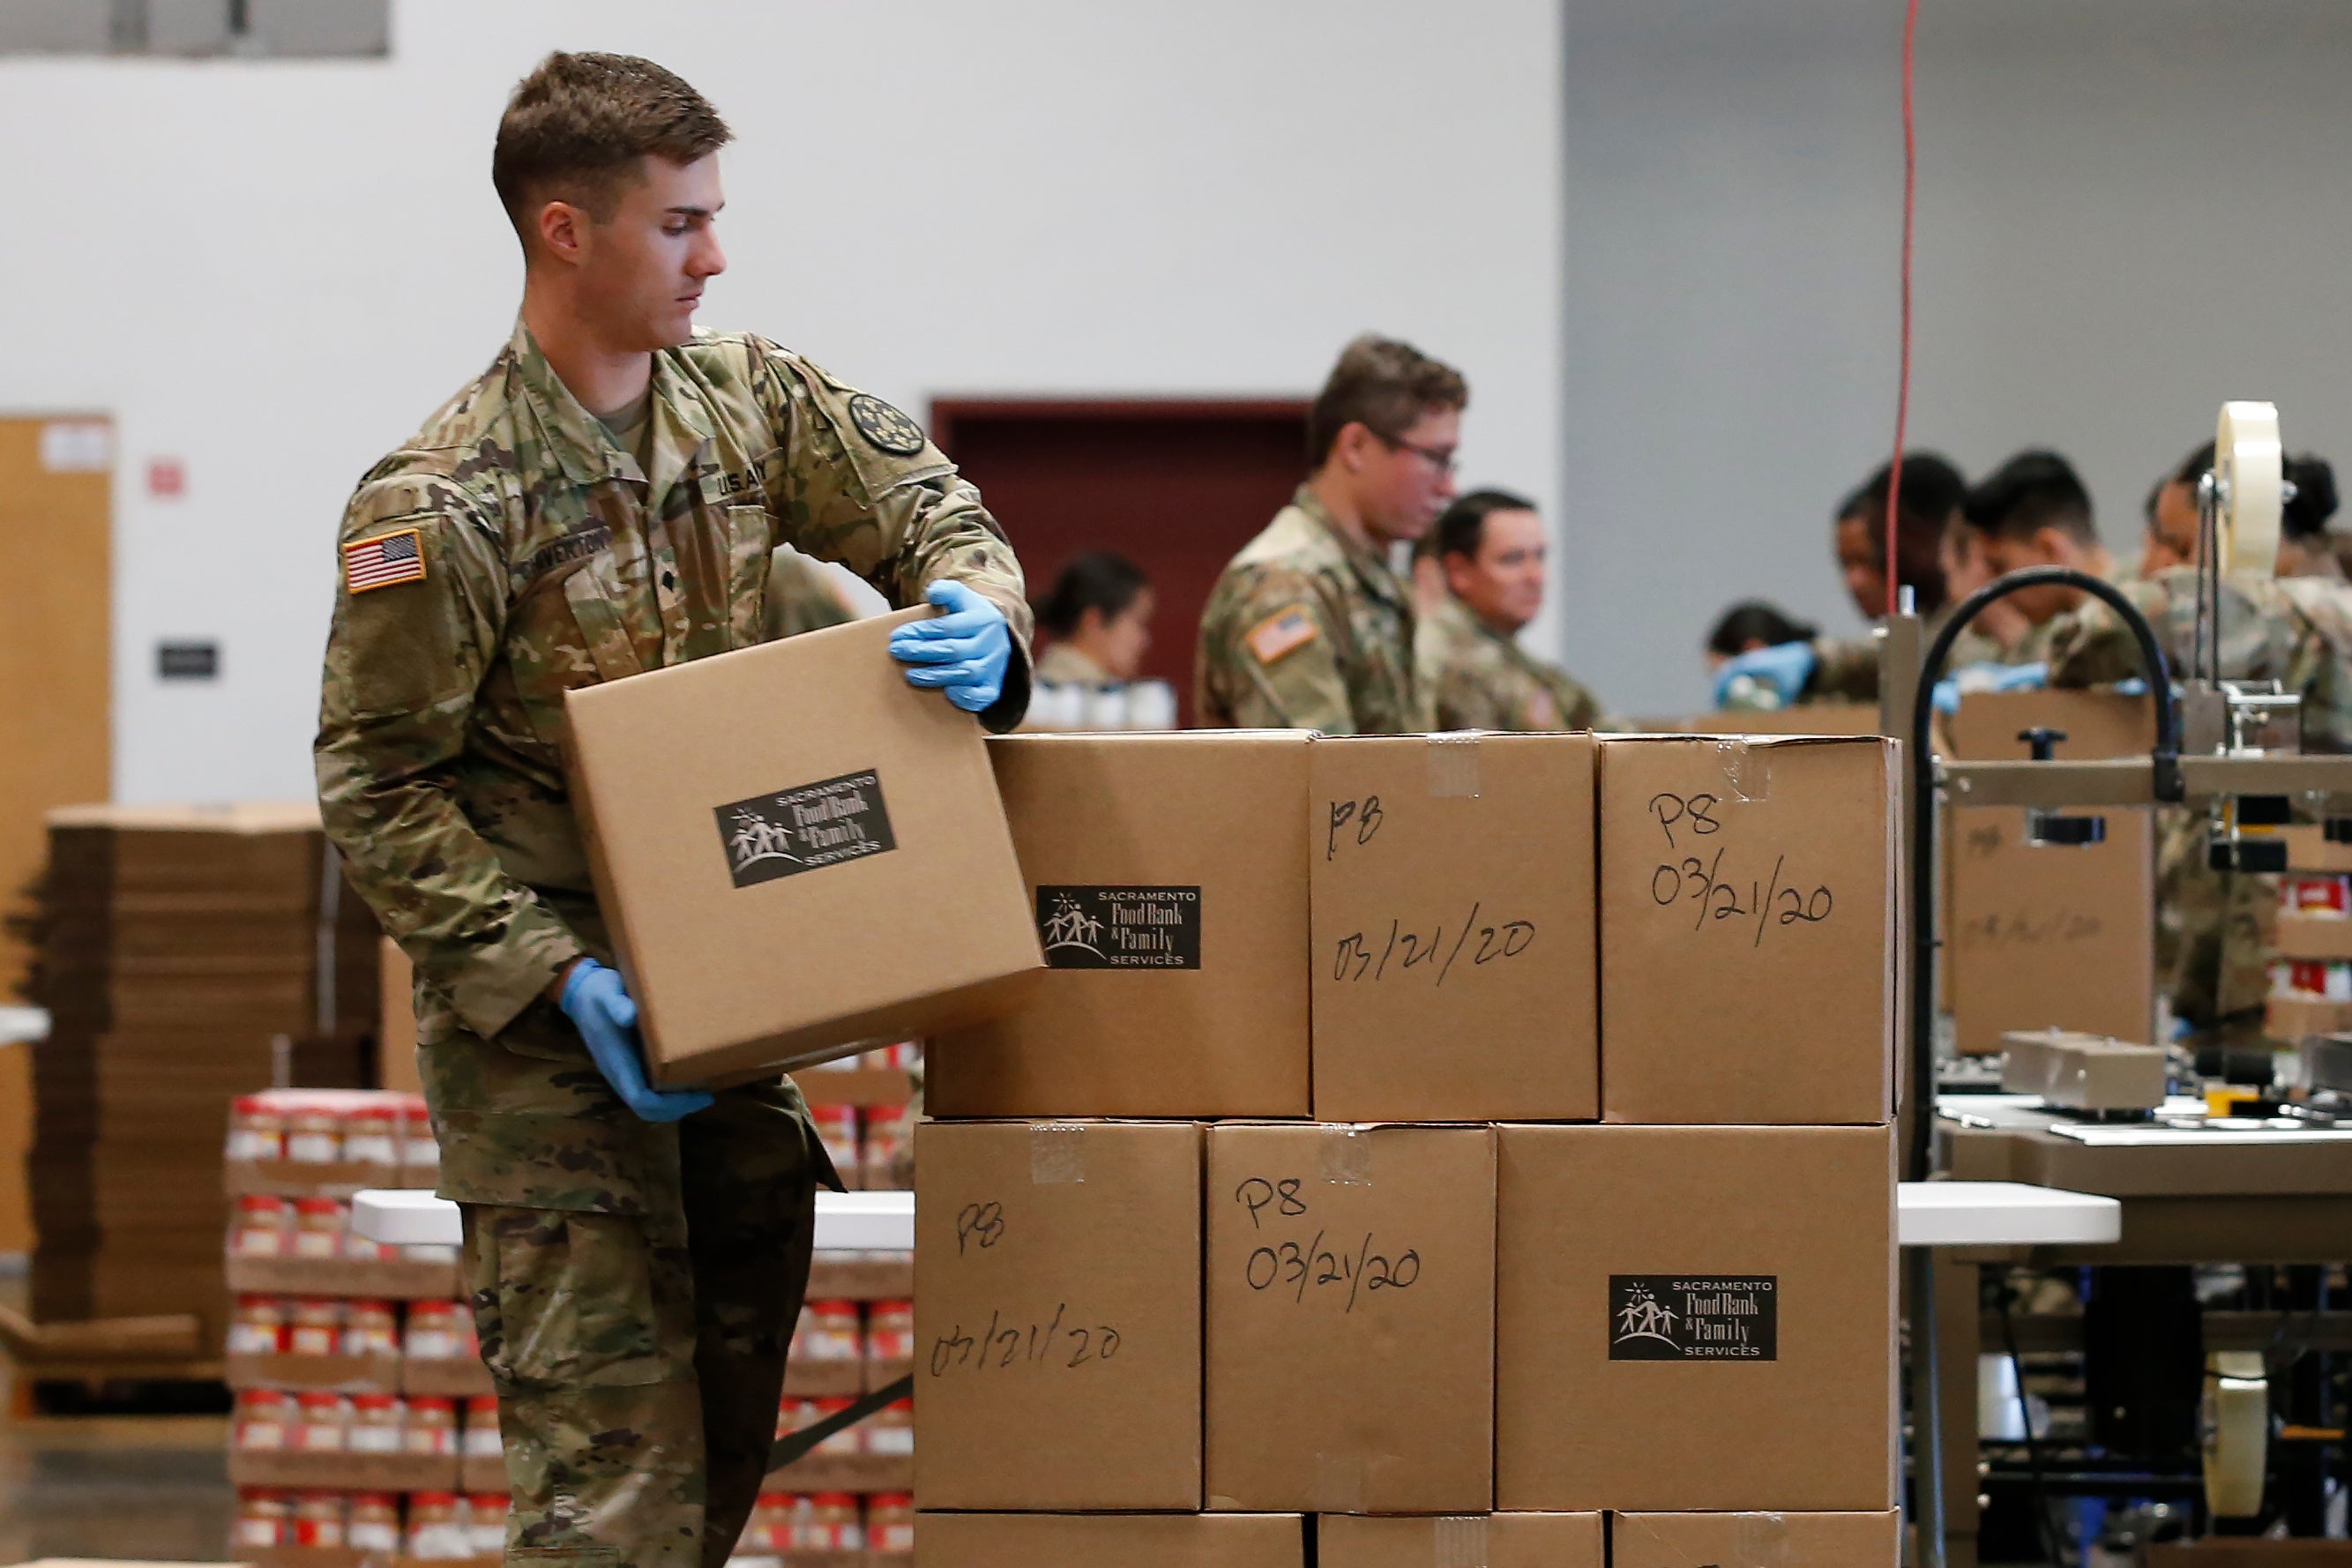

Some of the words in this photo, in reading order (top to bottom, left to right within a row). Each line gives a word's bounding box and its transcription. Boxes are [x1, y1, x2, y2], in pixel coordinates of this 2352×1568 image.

[775, 775, 877, 807] SACRAMENTO
[792, 798, 829, 827] Food
[827, 789, 870, 818] Bank
[1649, 793, 1720, 848] P8
[806, 818, 867, 848] Family
[803, 840, 881, 866] SERVICES
[1098, 892, 1196, 901] SACRAMENTO
[1652, 847, 1833, 948] 03/21/20
[1112, 903, 1146, 925] Food
[1147, 903, 1183, 925] Bank
[1111, 927, 1119, 940] &
[1120, 927, 1175, 956] Family
[1334, 901, 1535, 987] 03/21/20
[1110, 956, 1184, 966] SERVICES
[1236, 1177, 1306, 1229] P8
[958, 1201, 1004, 1256] P8
[1247, 1229, 1420, 1313] 03/21/20
[1672, 1281, 1773, 1291] SACRAMENTO
[1686, 1293, 1720, 1315] Food
[1722, 1293, 1758, 1315] Bank
[1685, 1318, 1693, 1330] &
[1695, 1318, 1750, 1347] Family
[1684, 1347, 1760, 1356] SERVICES
